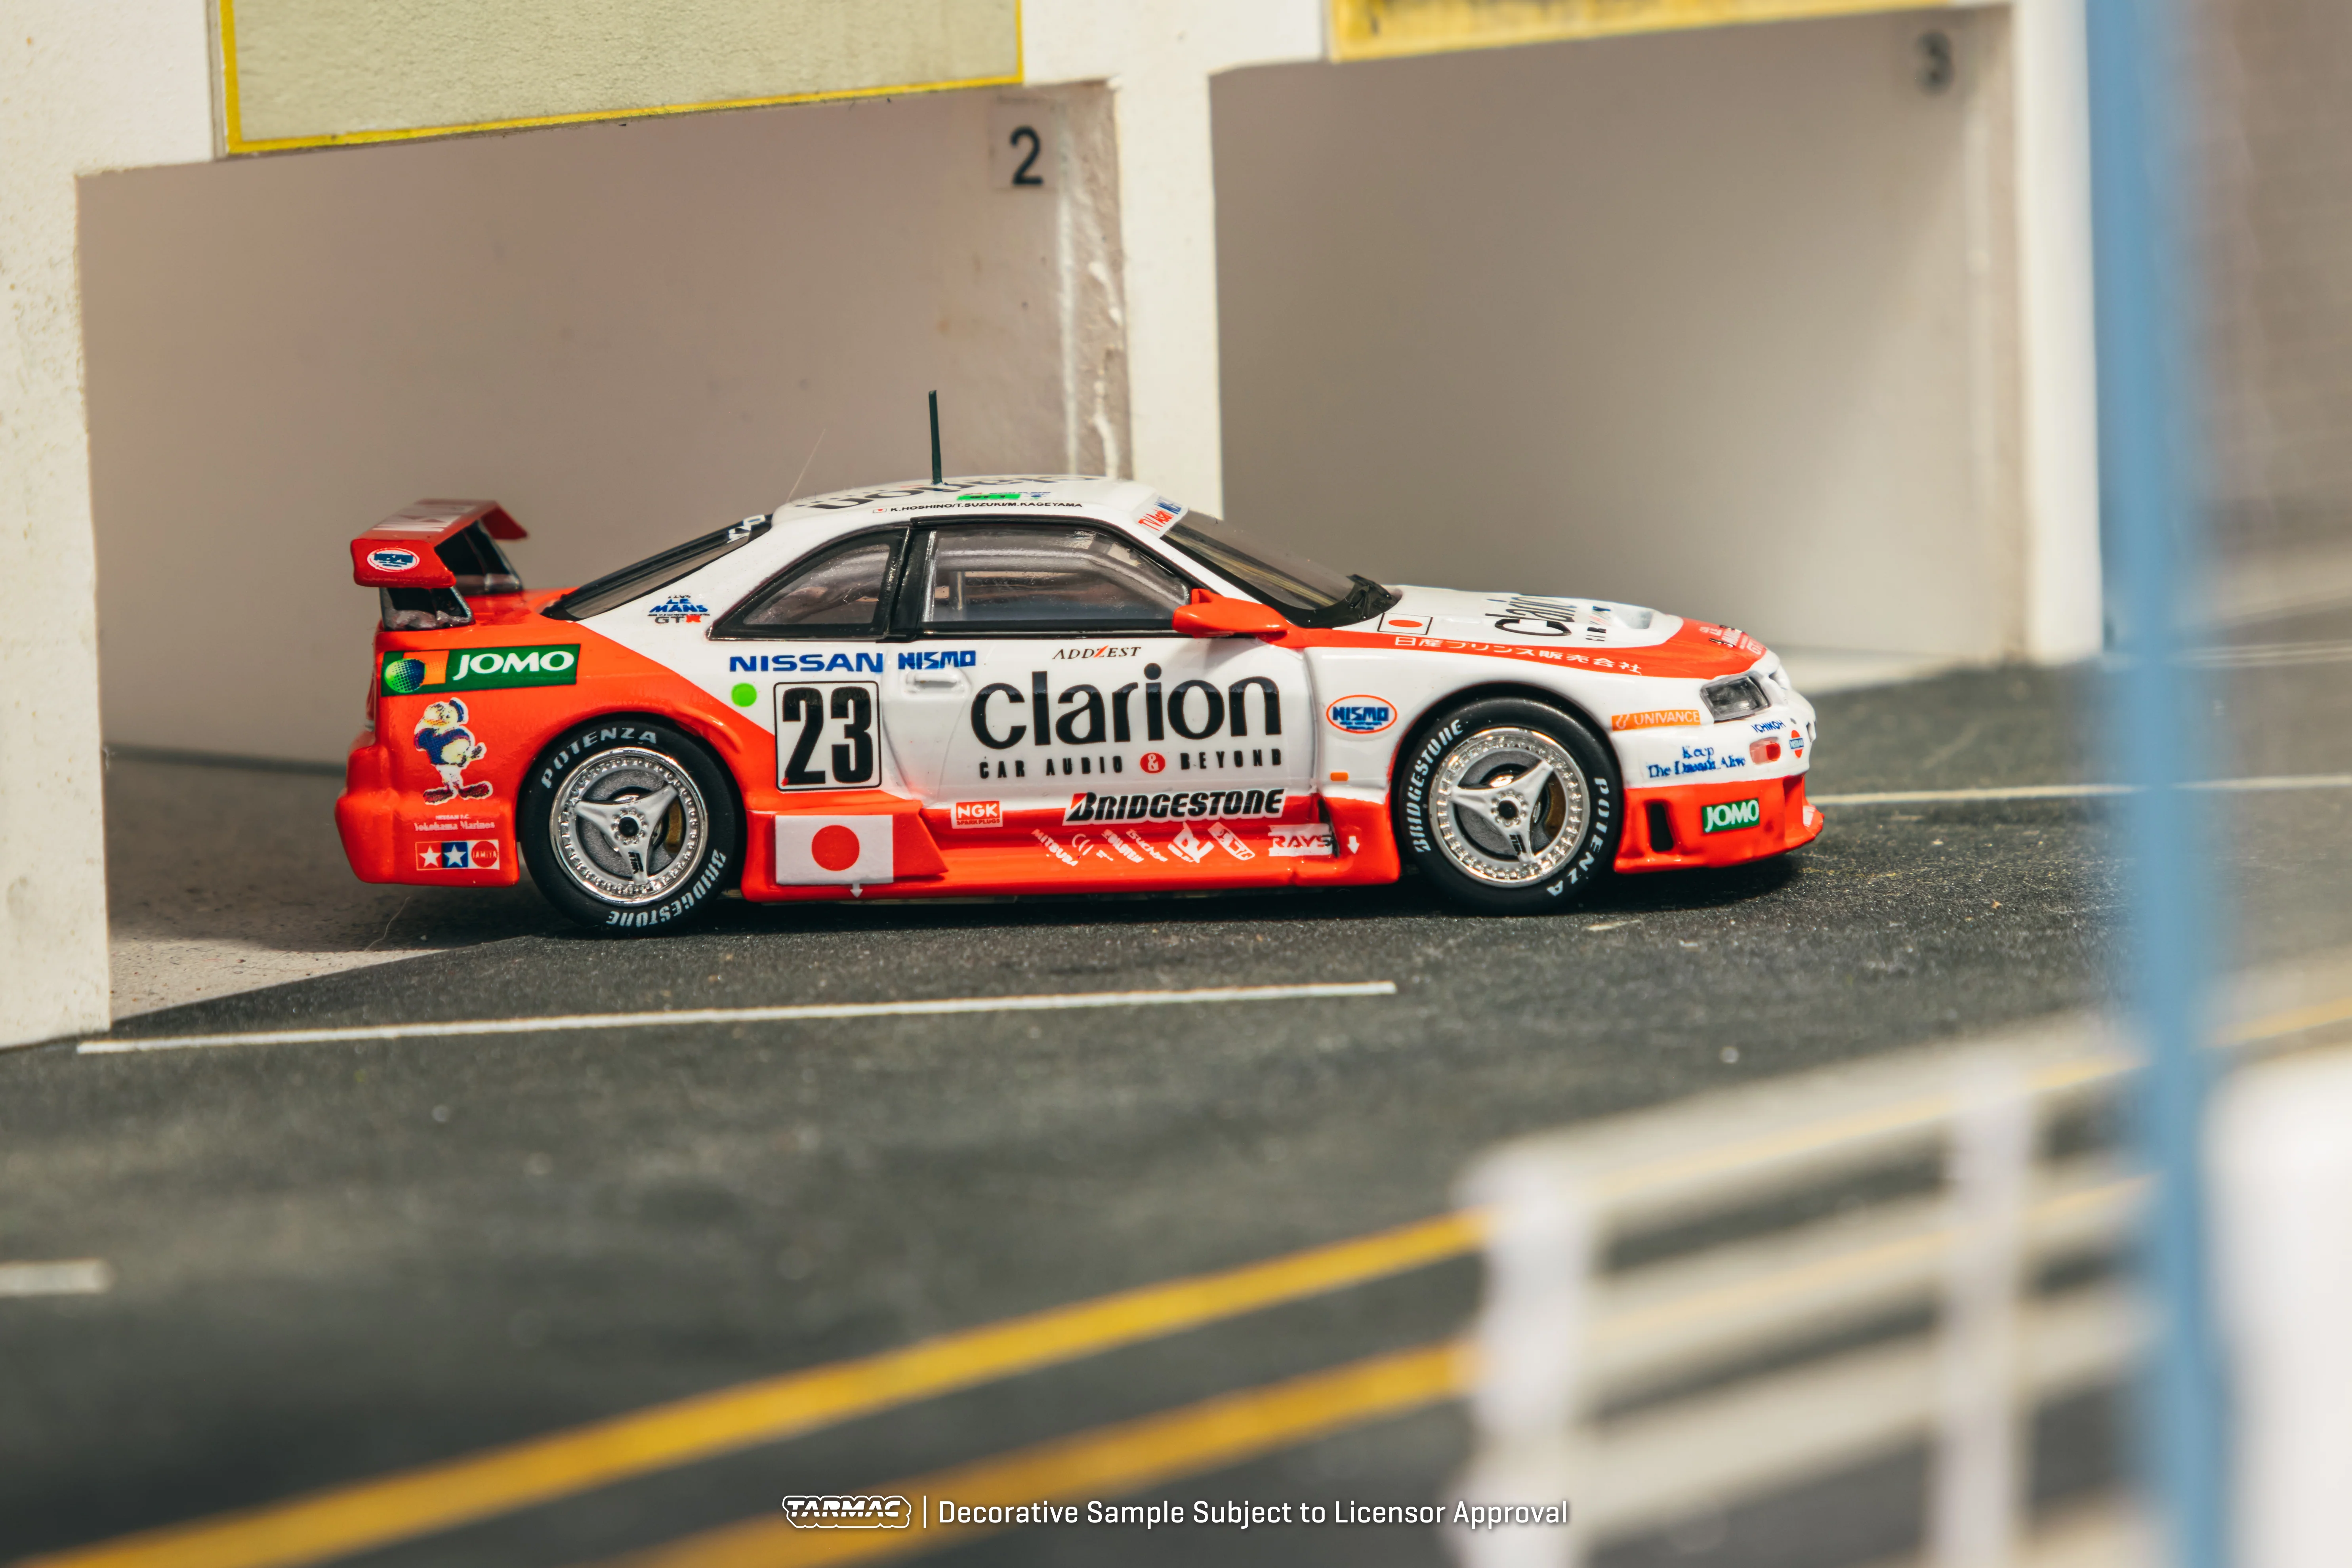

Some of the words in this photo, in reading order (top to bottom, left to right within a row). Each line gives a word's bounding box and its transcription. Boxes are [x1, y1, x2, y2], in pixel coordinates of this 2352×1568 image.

[1010, 125, 1043, 185] 2
[649, 604, 708, 613] MANS
[452, 650, 574, 681] JOMO
[729, 652, 883, 673] NISSAN
[898, 650, 976, 670] NISMO
[1052, 645, 1142, 660] ADDZEST
[1394, 637, 1642, 675] 日産プリンス販売会社
[971, 662, 1282, 750] clarion
[1332, 706, 1389, 721] NISMO
[1634, 711, 1700, 725] UNIVANCE
[782, 686, 873, 785] 23
[1751, 719, 1787, 733] ICHIKOH
[541, 727, 656, 789] POTENZA
[979, 759, 1025, 779] CAR
[1045, 756, 1123, 776] AUDIO
[1147, 753, 1159, 772] &
[1180, 748, 1282, 771] BEYOND
[1406, 719, 1463, 853] BRIDGESTONE
[958, 803, 998, 819] NGK
[1066, 788, 1285, 822] BRIDGESTONE
[1705, 799, 1759, 833] JOMO
[1268, 835, 1332, 848] RAYS
[1547, 777, 1610, 896] POTENZA
[606, 849, 727, 928] BRIDGESTONE
